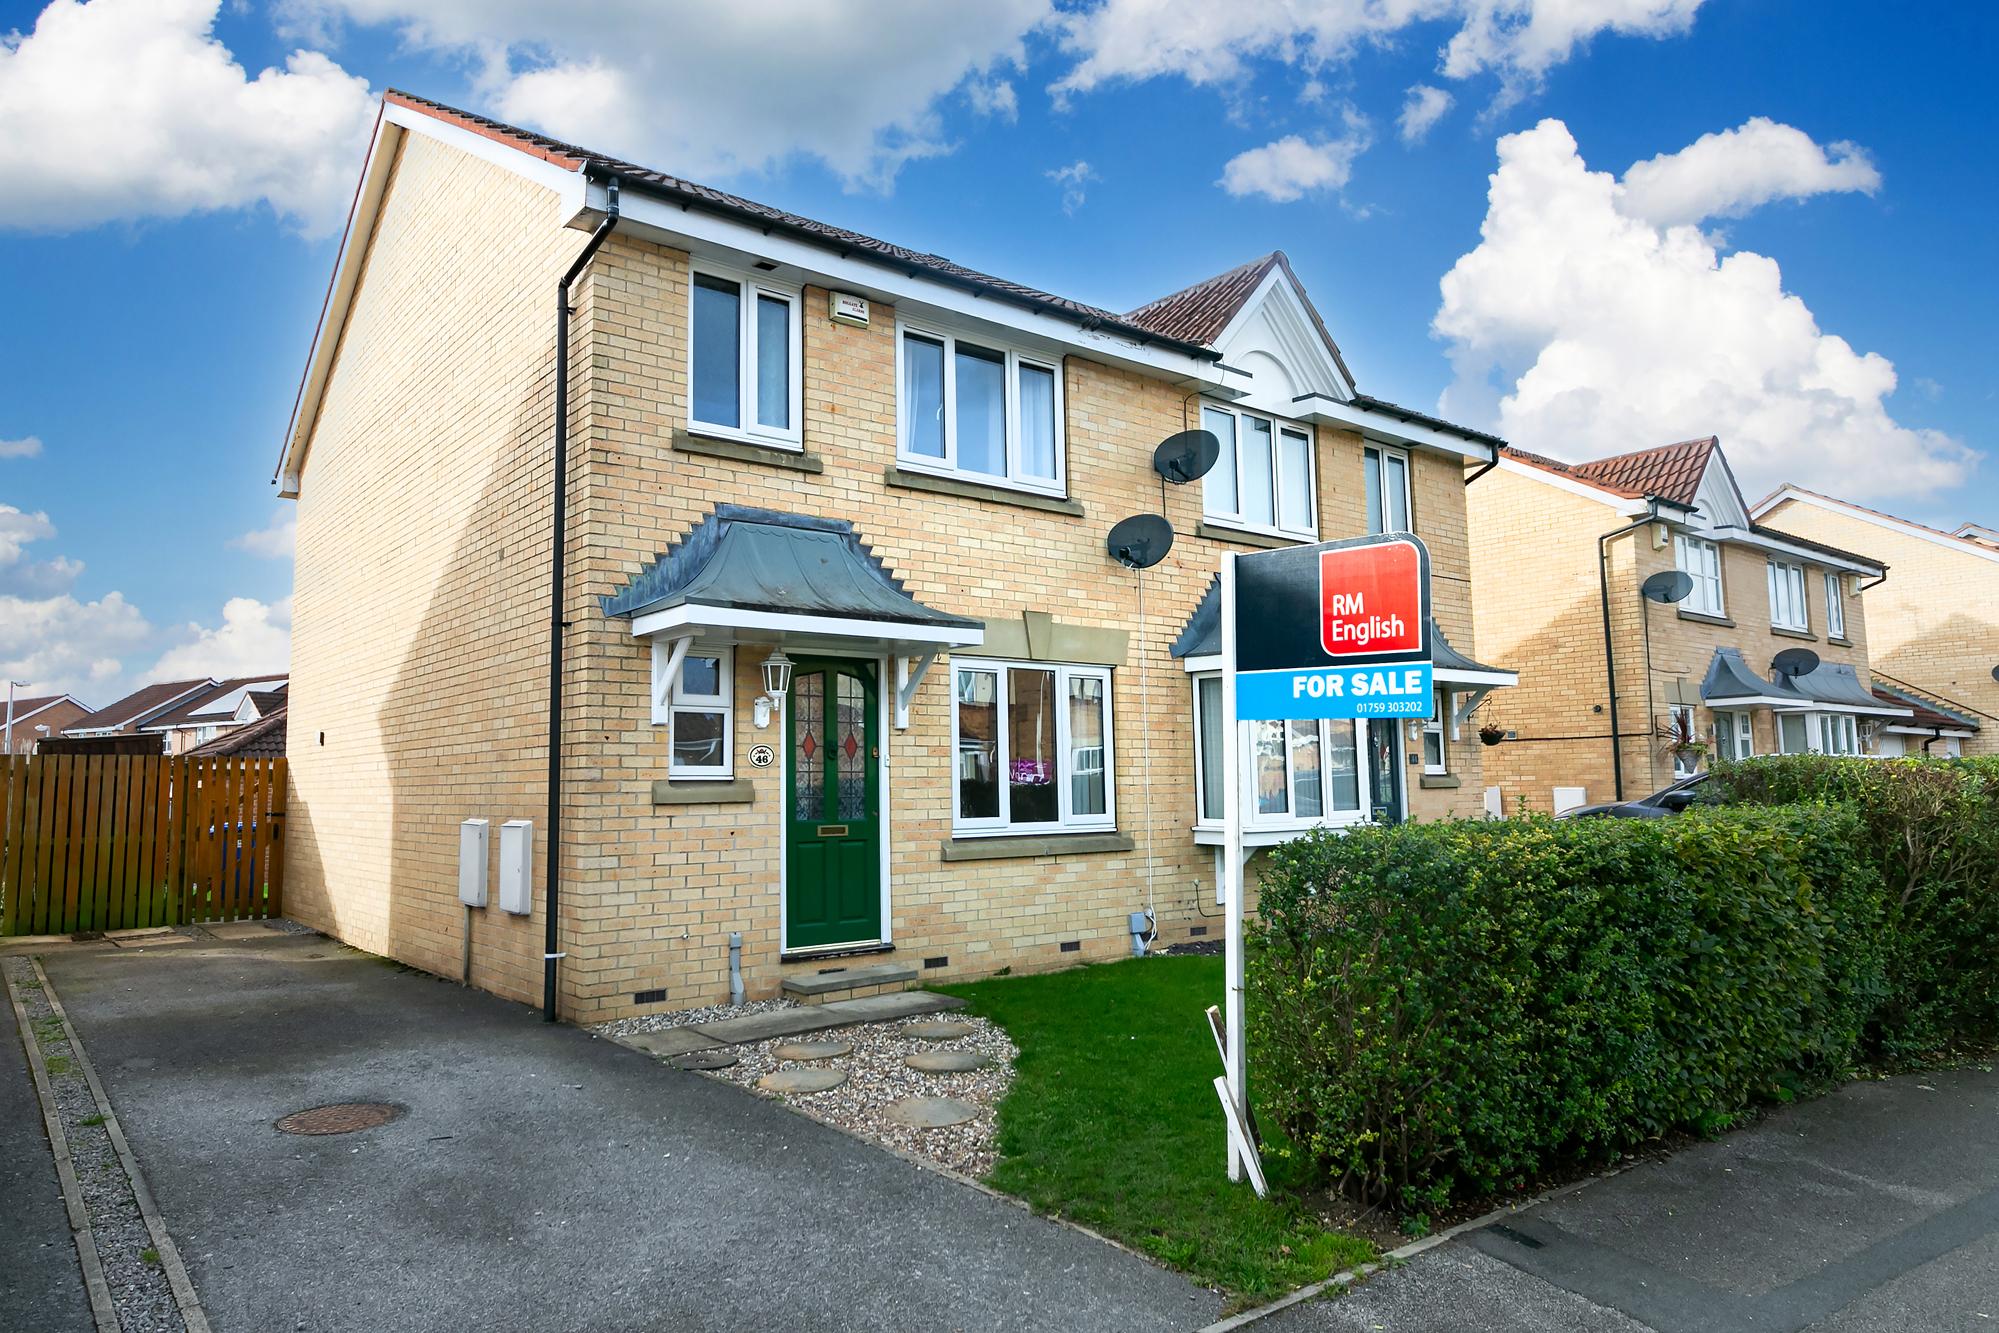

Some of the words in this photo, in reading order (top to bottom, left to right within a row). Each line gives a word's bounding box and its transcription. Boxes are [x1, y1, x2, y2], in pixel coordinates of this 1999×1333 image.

[1332, 592, 1364, 616] RM
[1332, 614, 1405, 645] English
[1292, 674, 1344, 698] FOR
[1351, 670, 1422, 696] SALE
[1356, 702, 1385, 713] 01759
[1387, 701, 1422, 713] 303202
[755, 755, 768, 764] 46
